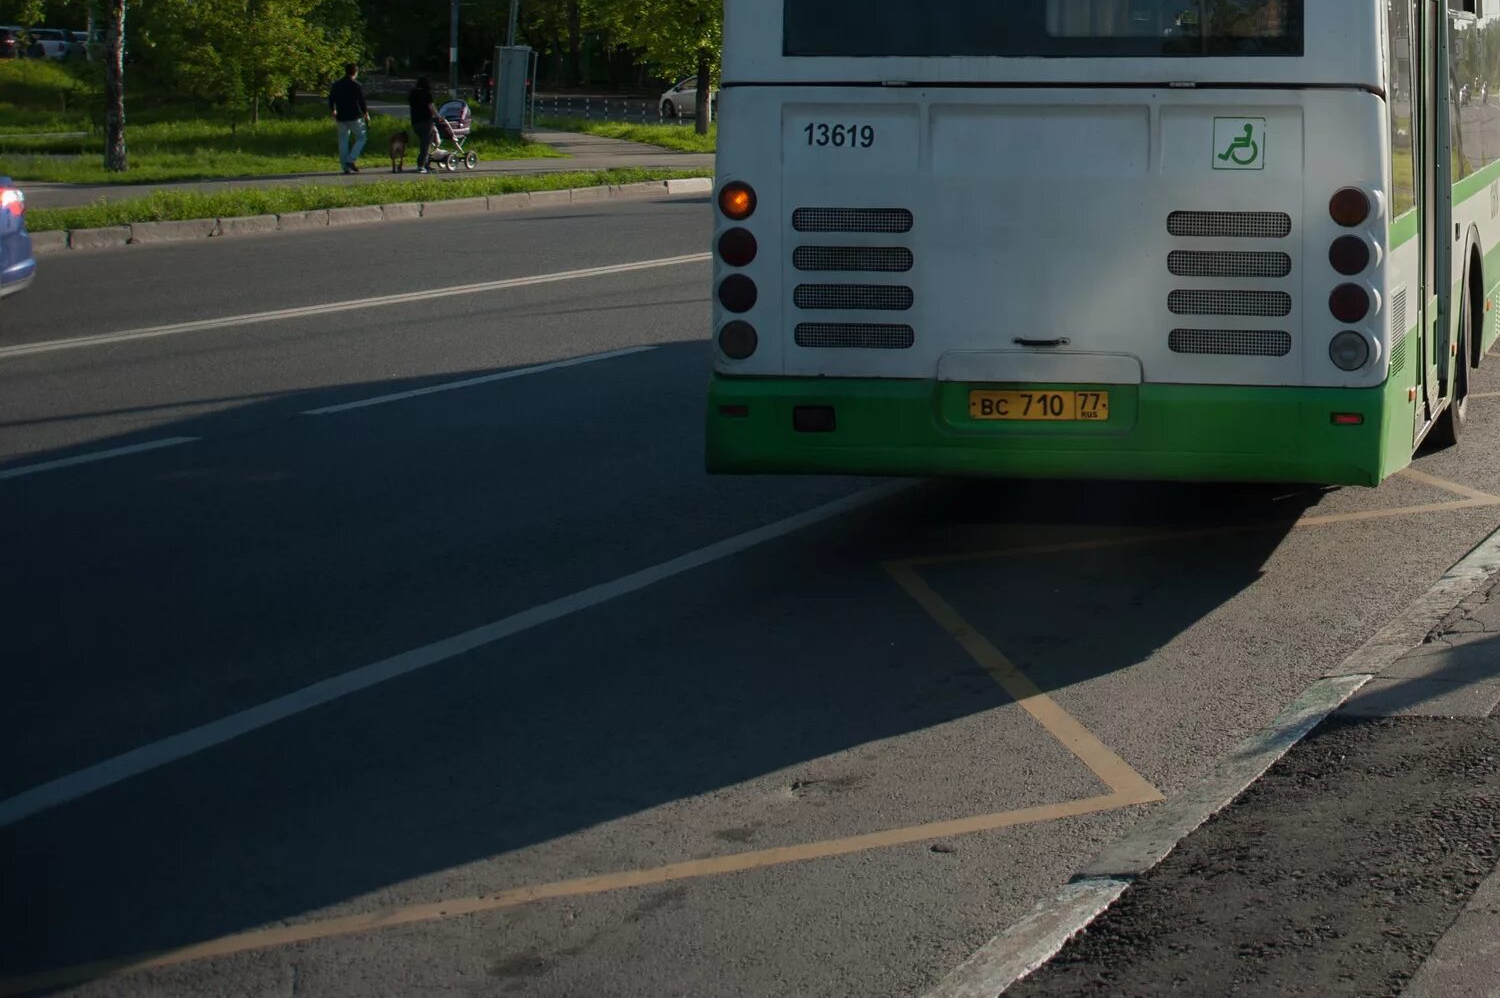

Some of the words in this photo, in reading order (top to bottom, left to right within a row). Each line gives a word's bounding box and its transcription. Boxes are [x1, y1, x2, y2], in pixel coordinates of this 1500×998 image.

[804, 123, 874, 148] 13619
[1020, 394, 1064, 416] 710
[1078, 393, 1100, 410] 77
